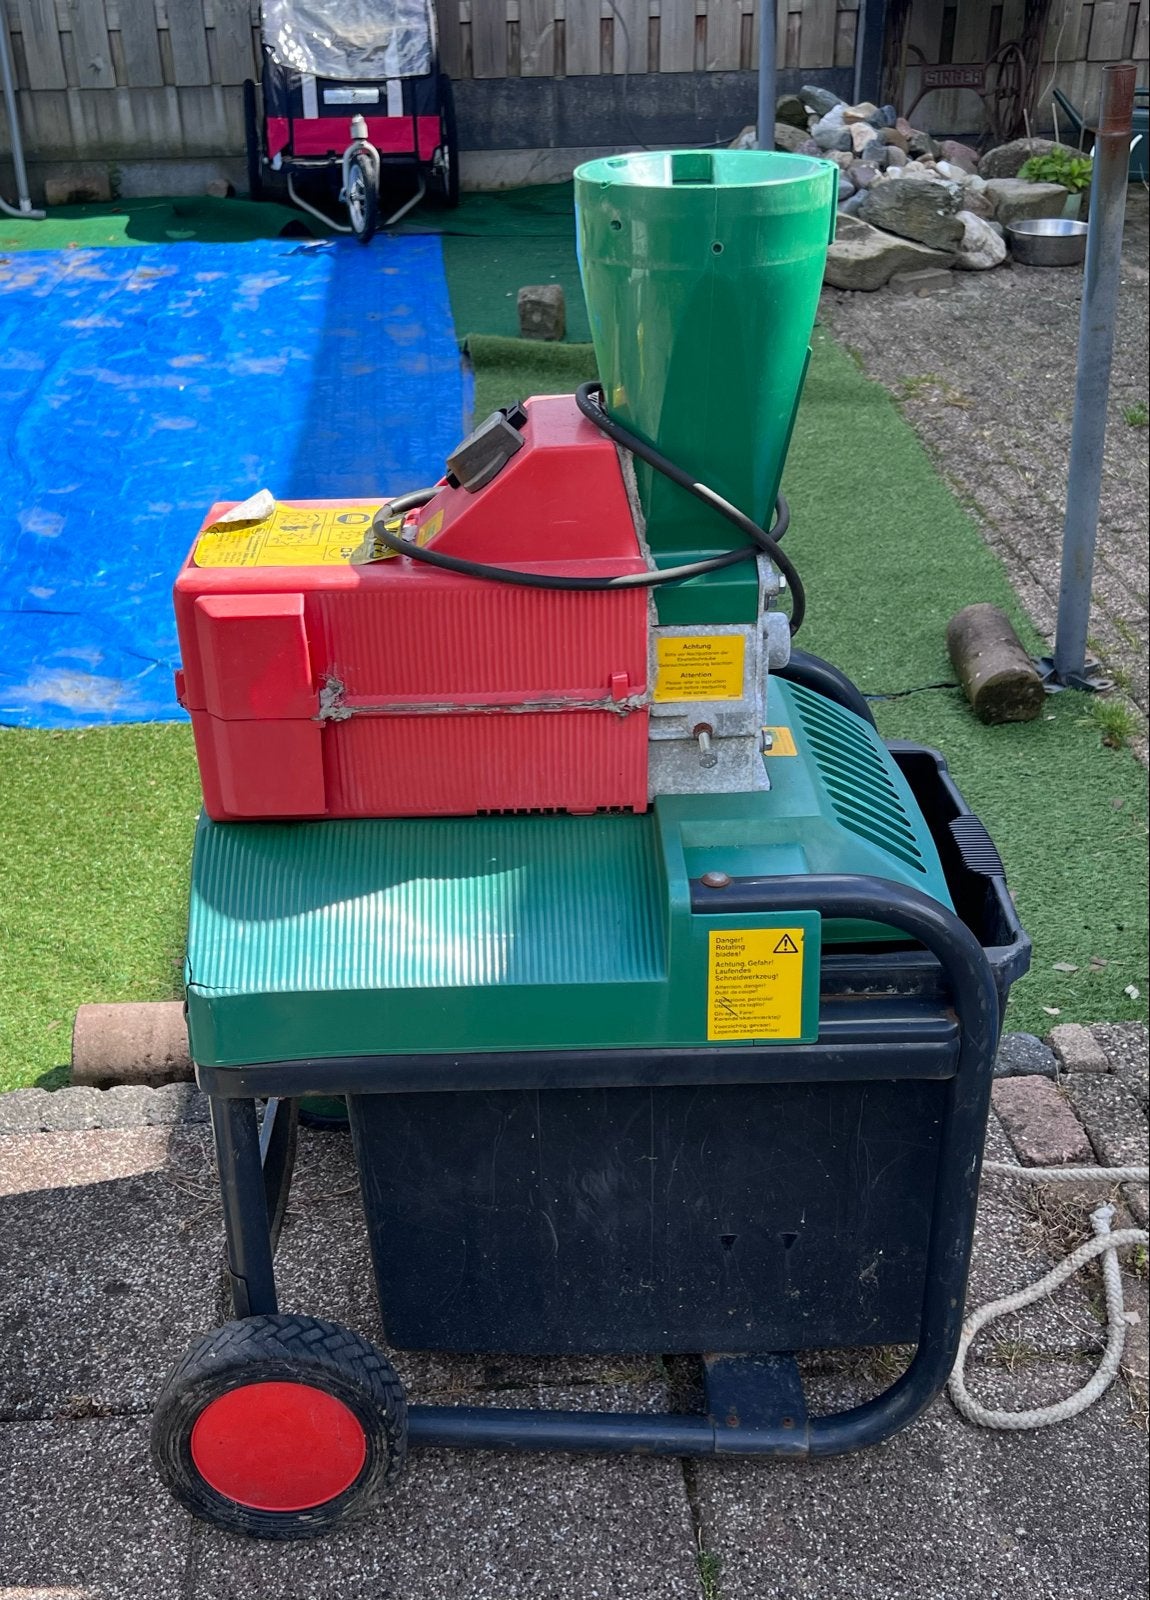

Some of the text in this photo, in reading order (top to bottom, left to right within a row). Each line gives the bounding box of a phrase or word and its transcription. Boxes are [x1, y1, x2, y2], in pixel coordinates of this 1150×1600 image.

[716, 937, 743, 945] Danger!
[715, 944, 746, 952] Rotating
[715, 974, 779, 982] Schneidwerkzeug!
